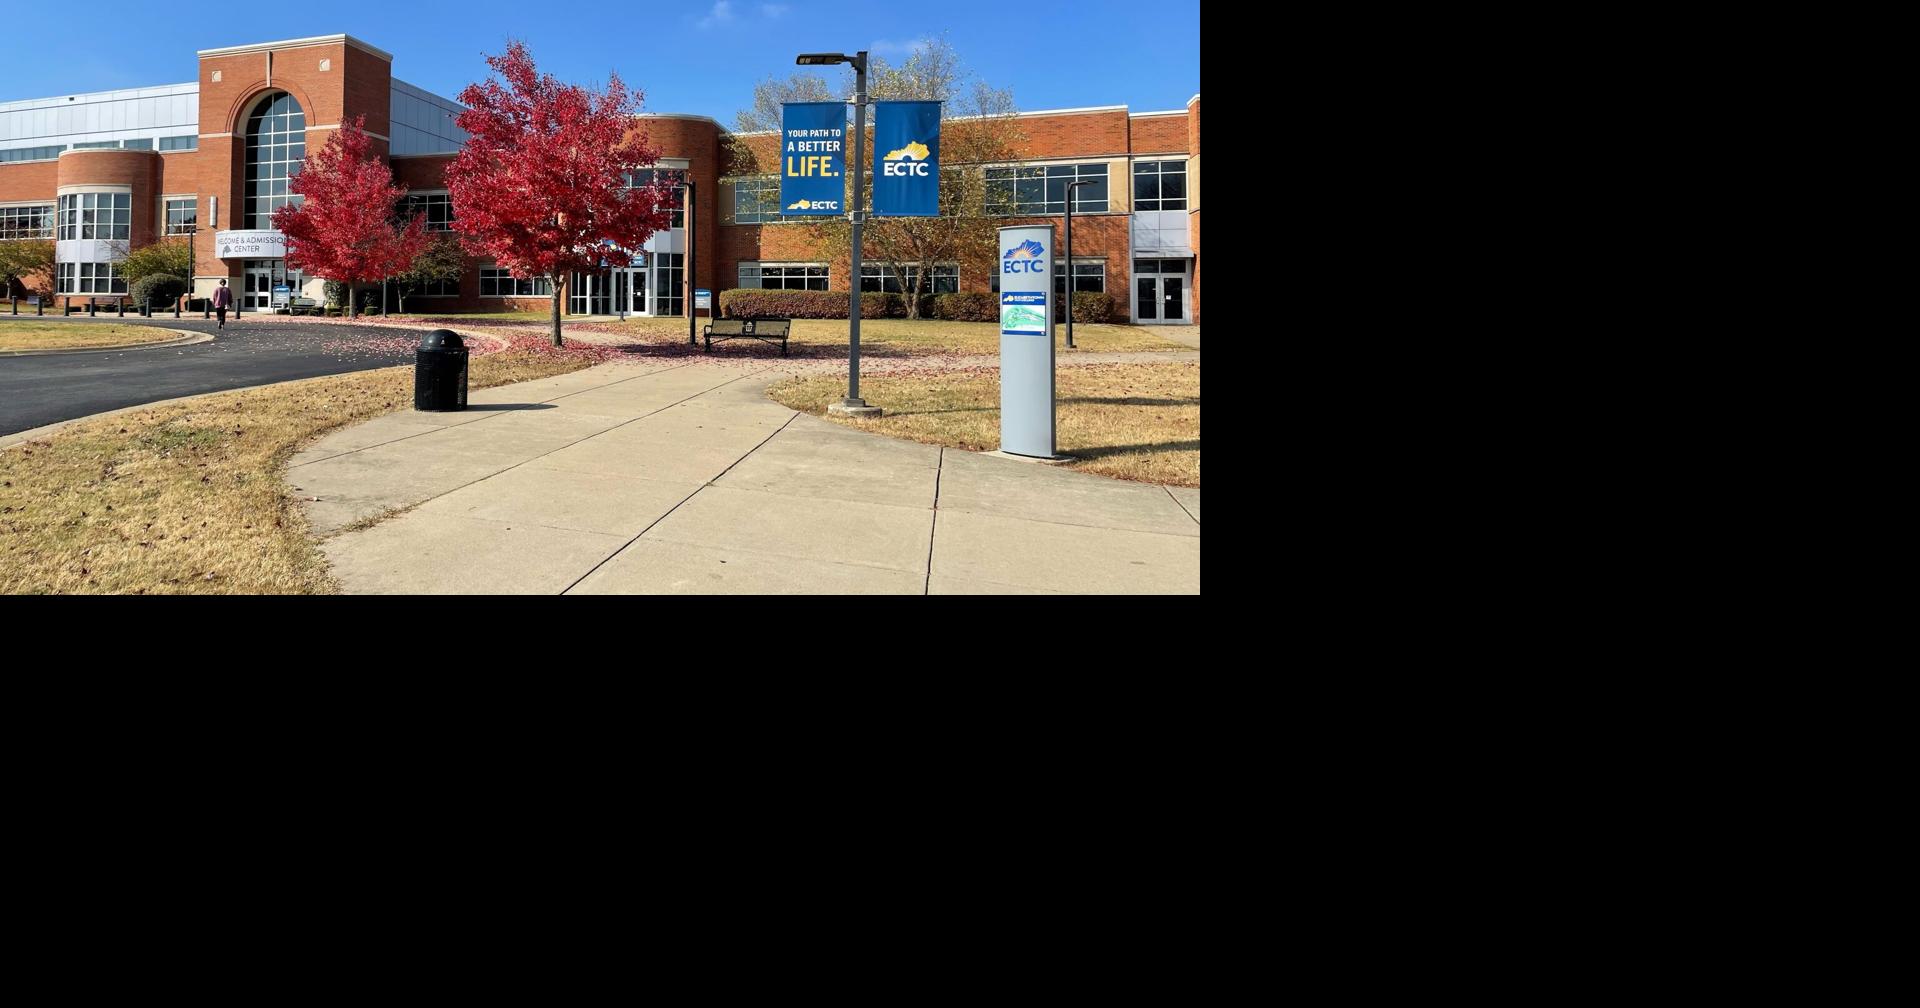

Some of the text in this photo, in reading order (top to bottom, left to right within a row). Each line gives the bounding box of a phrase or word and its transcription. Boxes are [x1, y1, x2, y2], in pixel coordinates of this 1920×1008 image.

[788, 128, 841, 138] YOUR PATH TO
[787, 140, 841, 152] A BETTER
[787, 156, 839, 177] LIFE.
[883, 162, 929, 177] ECTC
[811, 201, 838, 210] ECTC
[1004, 259, 1043, 273] ECTC
